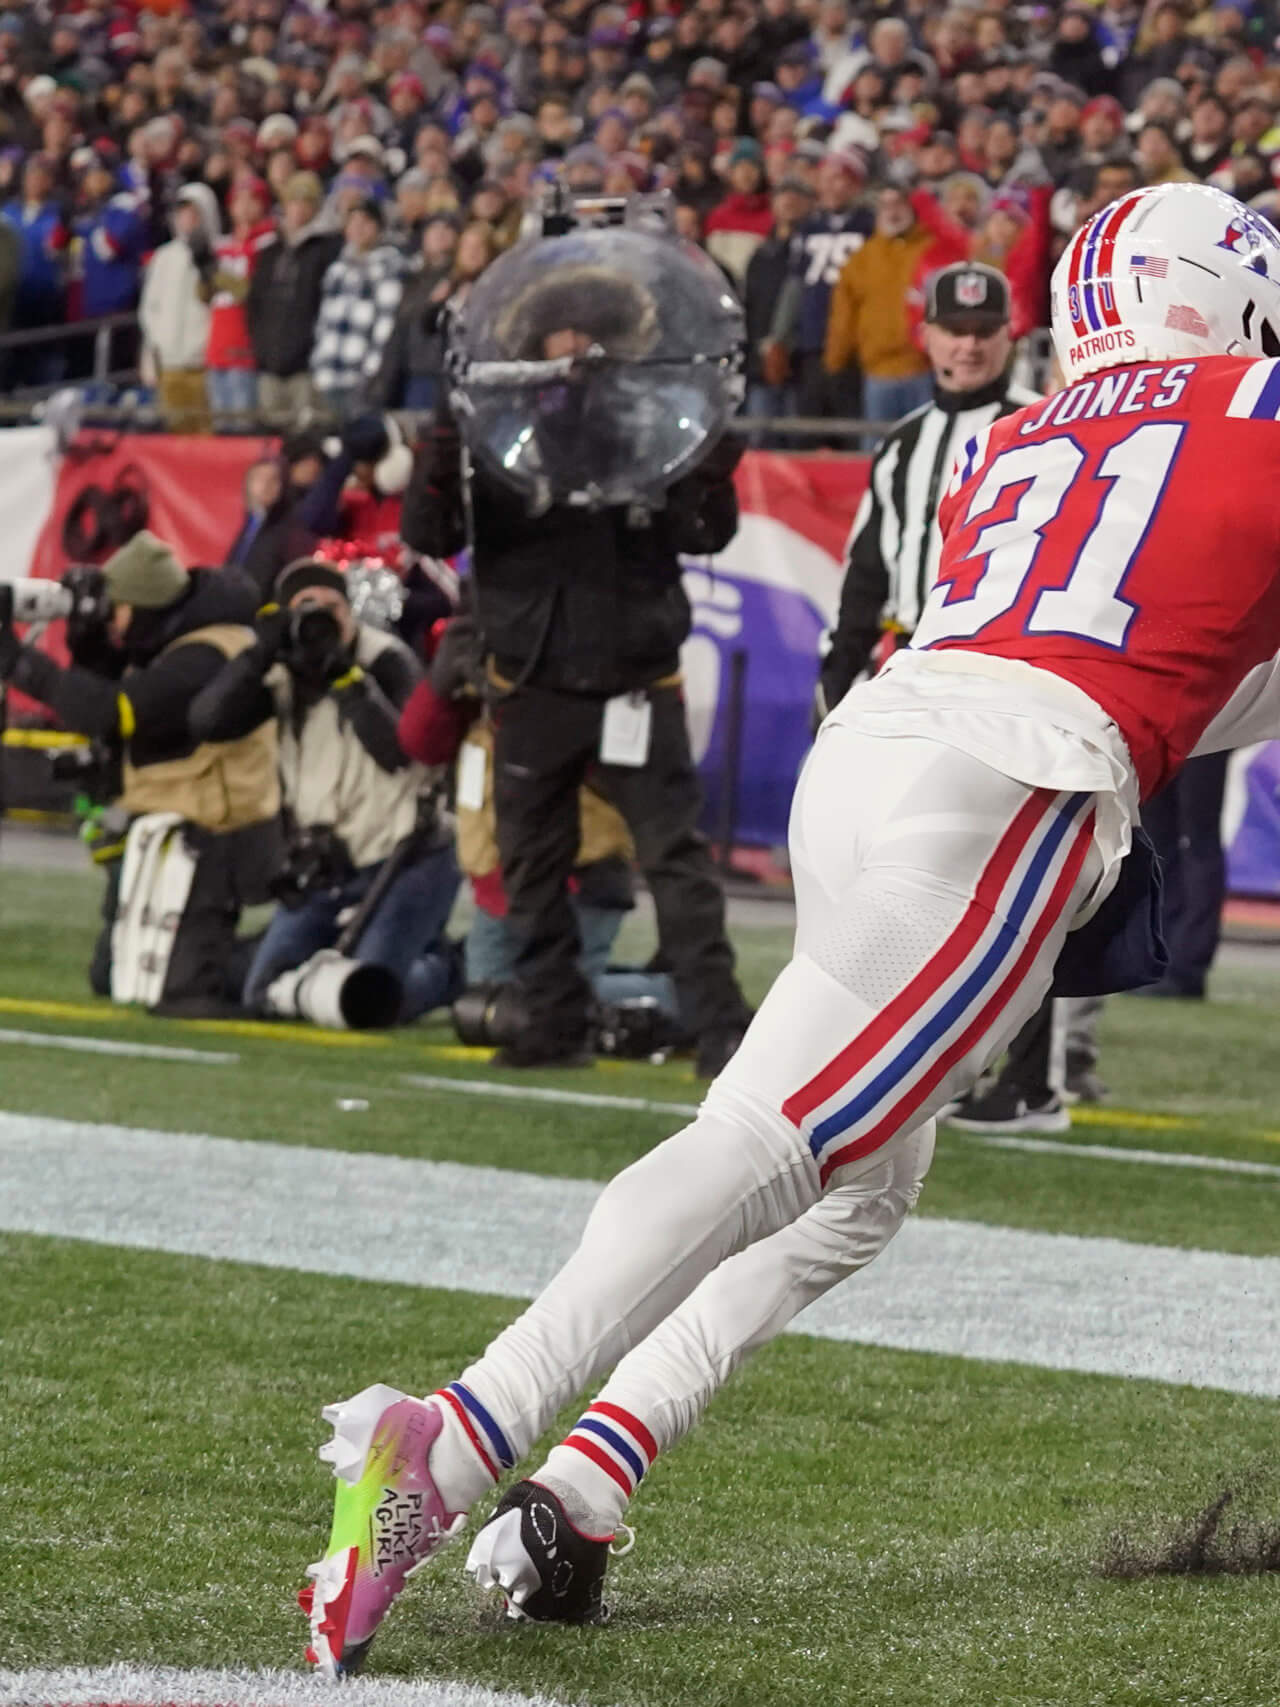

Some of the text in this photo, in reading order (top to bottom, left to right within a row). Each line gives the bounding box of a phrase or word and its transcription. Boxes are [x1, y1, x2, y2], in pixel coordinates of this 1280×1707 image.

[1069, 328, 1136, 366] PATRIOTS
[1019, 362, 1198, 436] JONES
[907, 420, 1190, 653] 31
[394, 1503, 411, 1564] LIKE
[406, 1493, 423, 1557] PLAY
